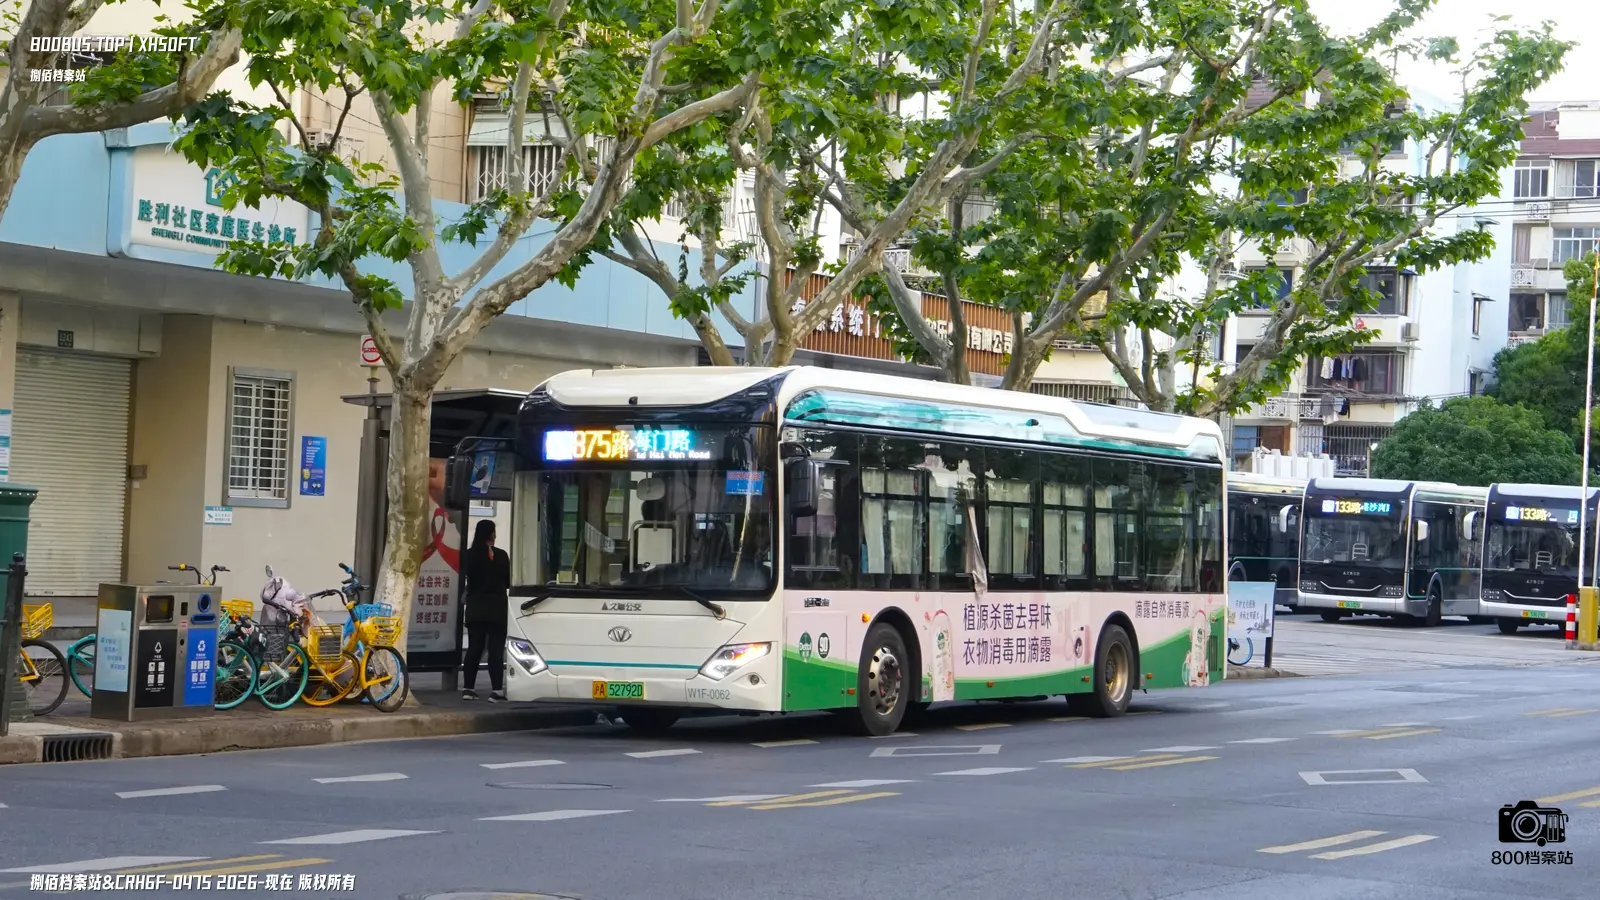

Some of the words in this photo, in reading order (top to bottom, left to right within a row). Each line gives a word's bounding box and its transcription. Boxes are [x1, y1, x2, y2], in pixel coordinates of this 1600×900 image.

[137, 198, 297, 247] 胜利社区家庭医生诊所
[151, 227, 184, 241] SHENGLI
[573, 430, 630, 459] 875路
[688, 450, 711, 459] Road
[418, 575, 450, 588] 社会共治
[963, 602, 1052, 631] 植源杀菌去异味
[1135, 600, 1190, 619] 滴露自然消毒液
[962, 636, 1052, 666] 衣物消毒用滴露
[687, 687, 731, 700] W1F-0062
